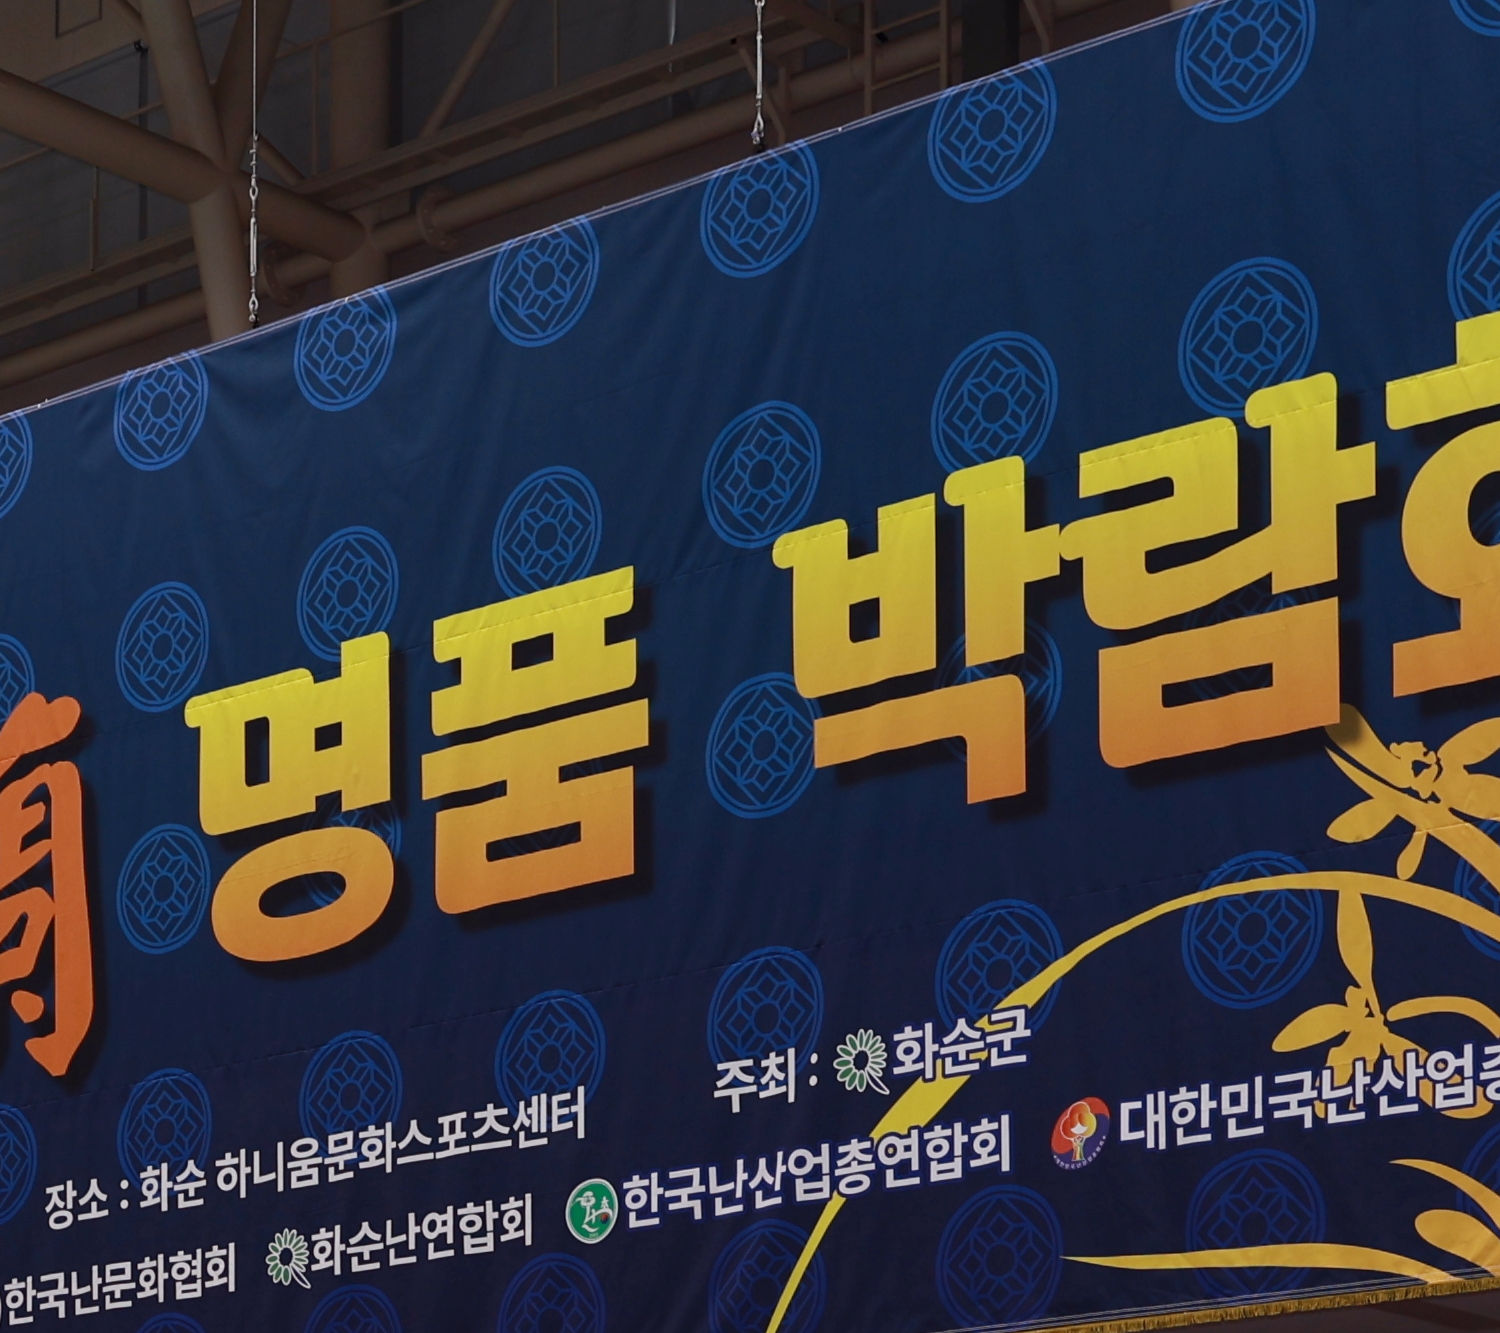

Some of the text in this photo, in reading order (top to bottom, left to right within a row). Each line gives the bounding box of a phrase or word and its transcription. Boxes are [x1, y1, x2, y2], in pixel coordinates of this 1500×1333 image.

[183, 563, 649, 964] 명품
[713, 1048, 795, 1113] 주최
[893, 1008, 1031, 1079] 화순군
[45, 1178, 108, 1230] 장소
[140, 1158, 206, 1213] 화순
[216, 1086, 585, 1199] 하니움문화스포츠센터
[310, 1193, 533, 1281] 화순난연합회
[622, 1114, 1012, 1229] 한국난산업총연합회
